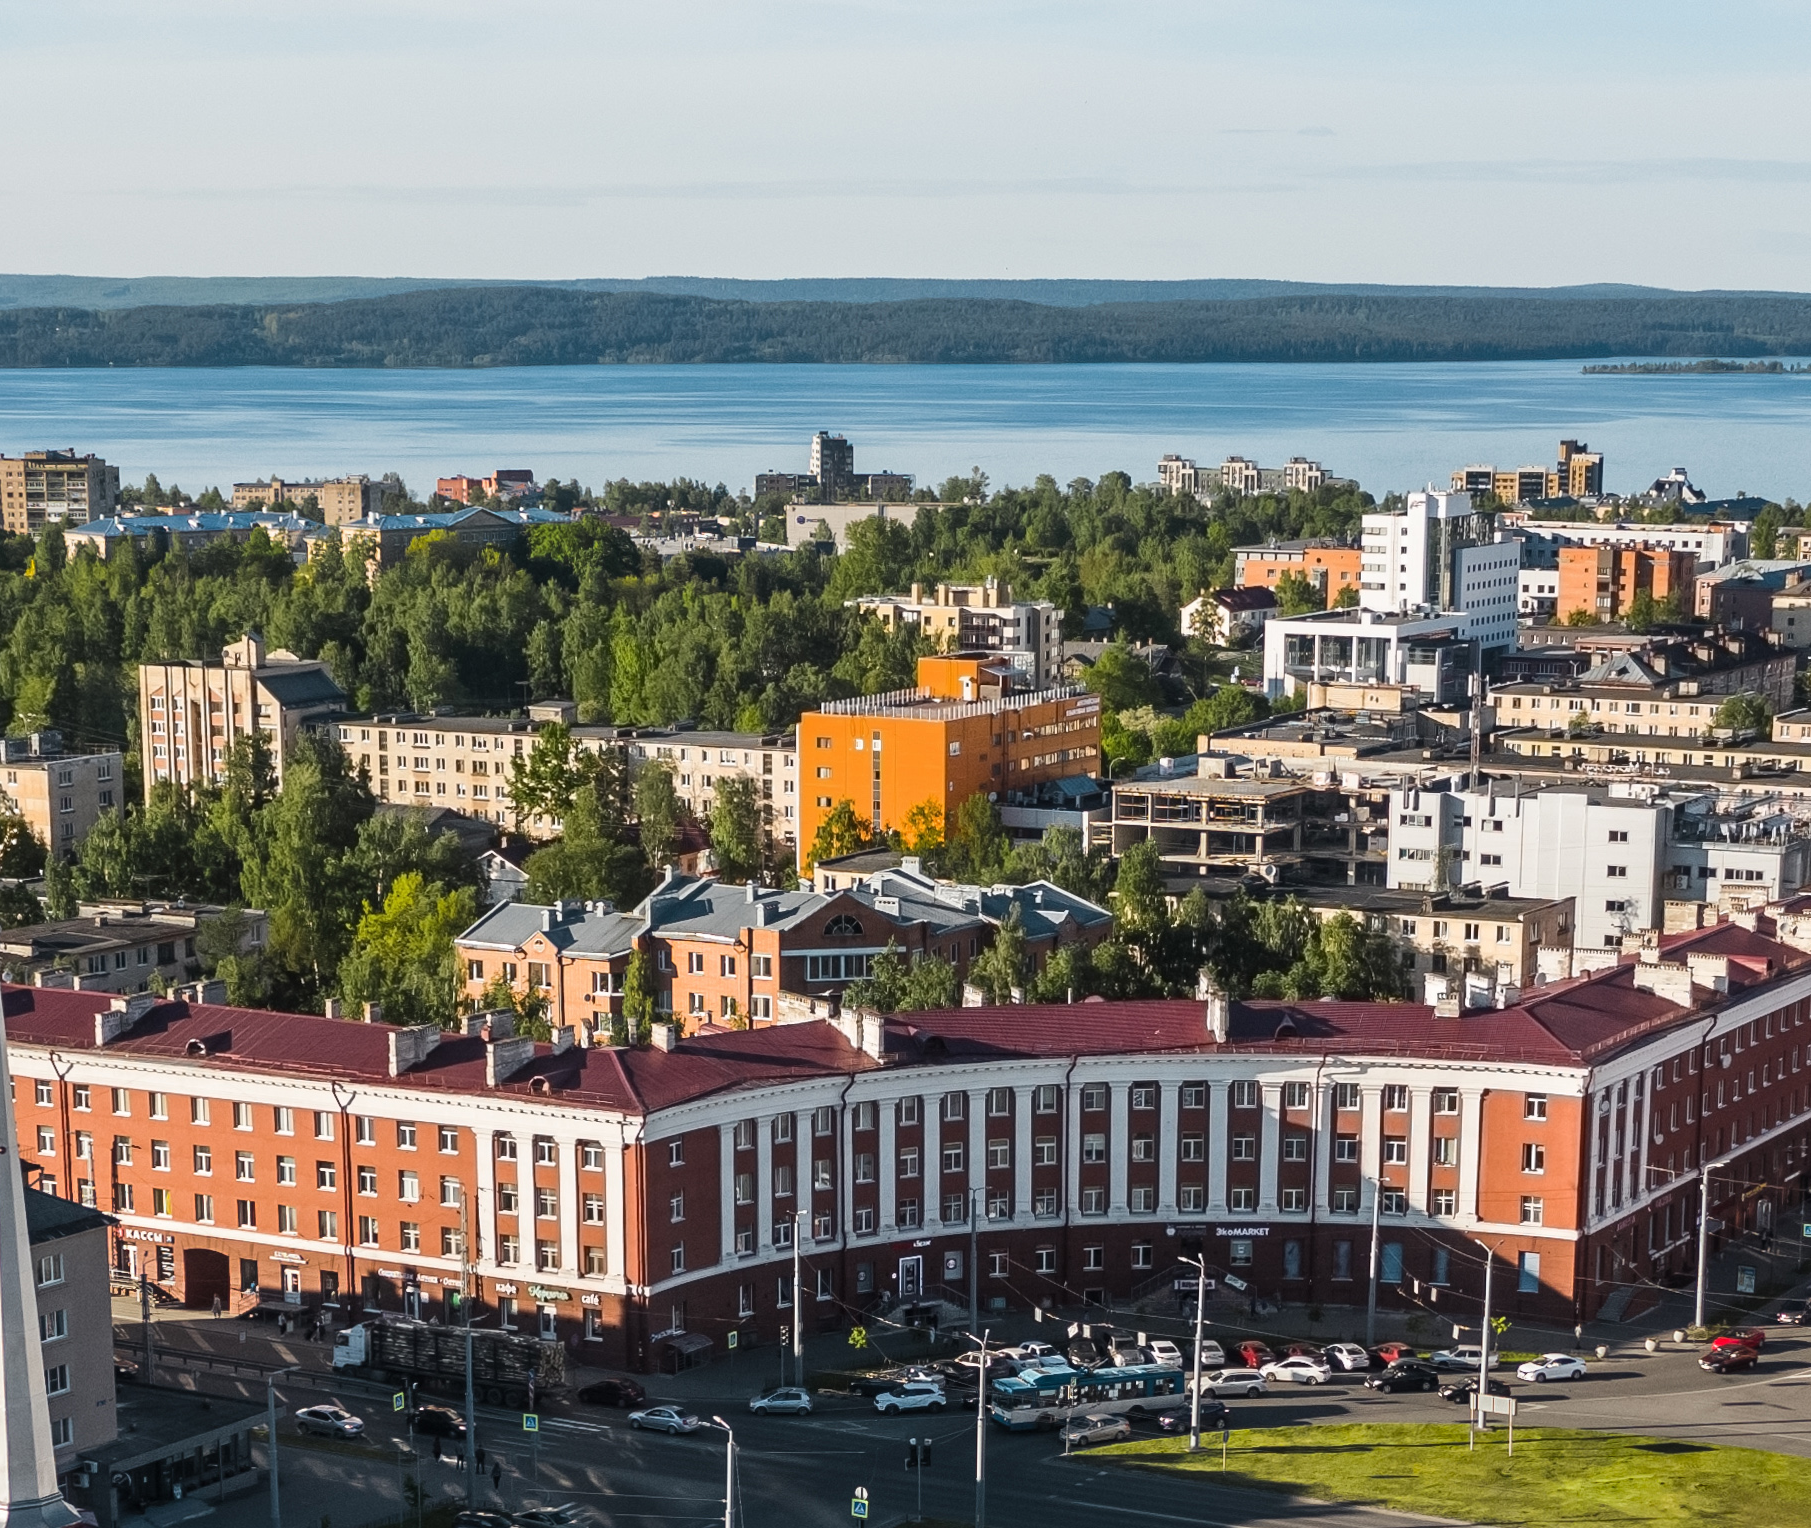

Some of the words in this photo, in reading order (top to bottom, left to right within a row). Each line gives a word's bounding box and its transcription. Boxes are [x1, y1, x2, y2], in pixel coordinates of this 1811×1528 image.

[125, 1228, 163, 1243] КАССЫ
[495, 1282, 517, 1296] кафе
[581, 1292, 601, 1306] café
